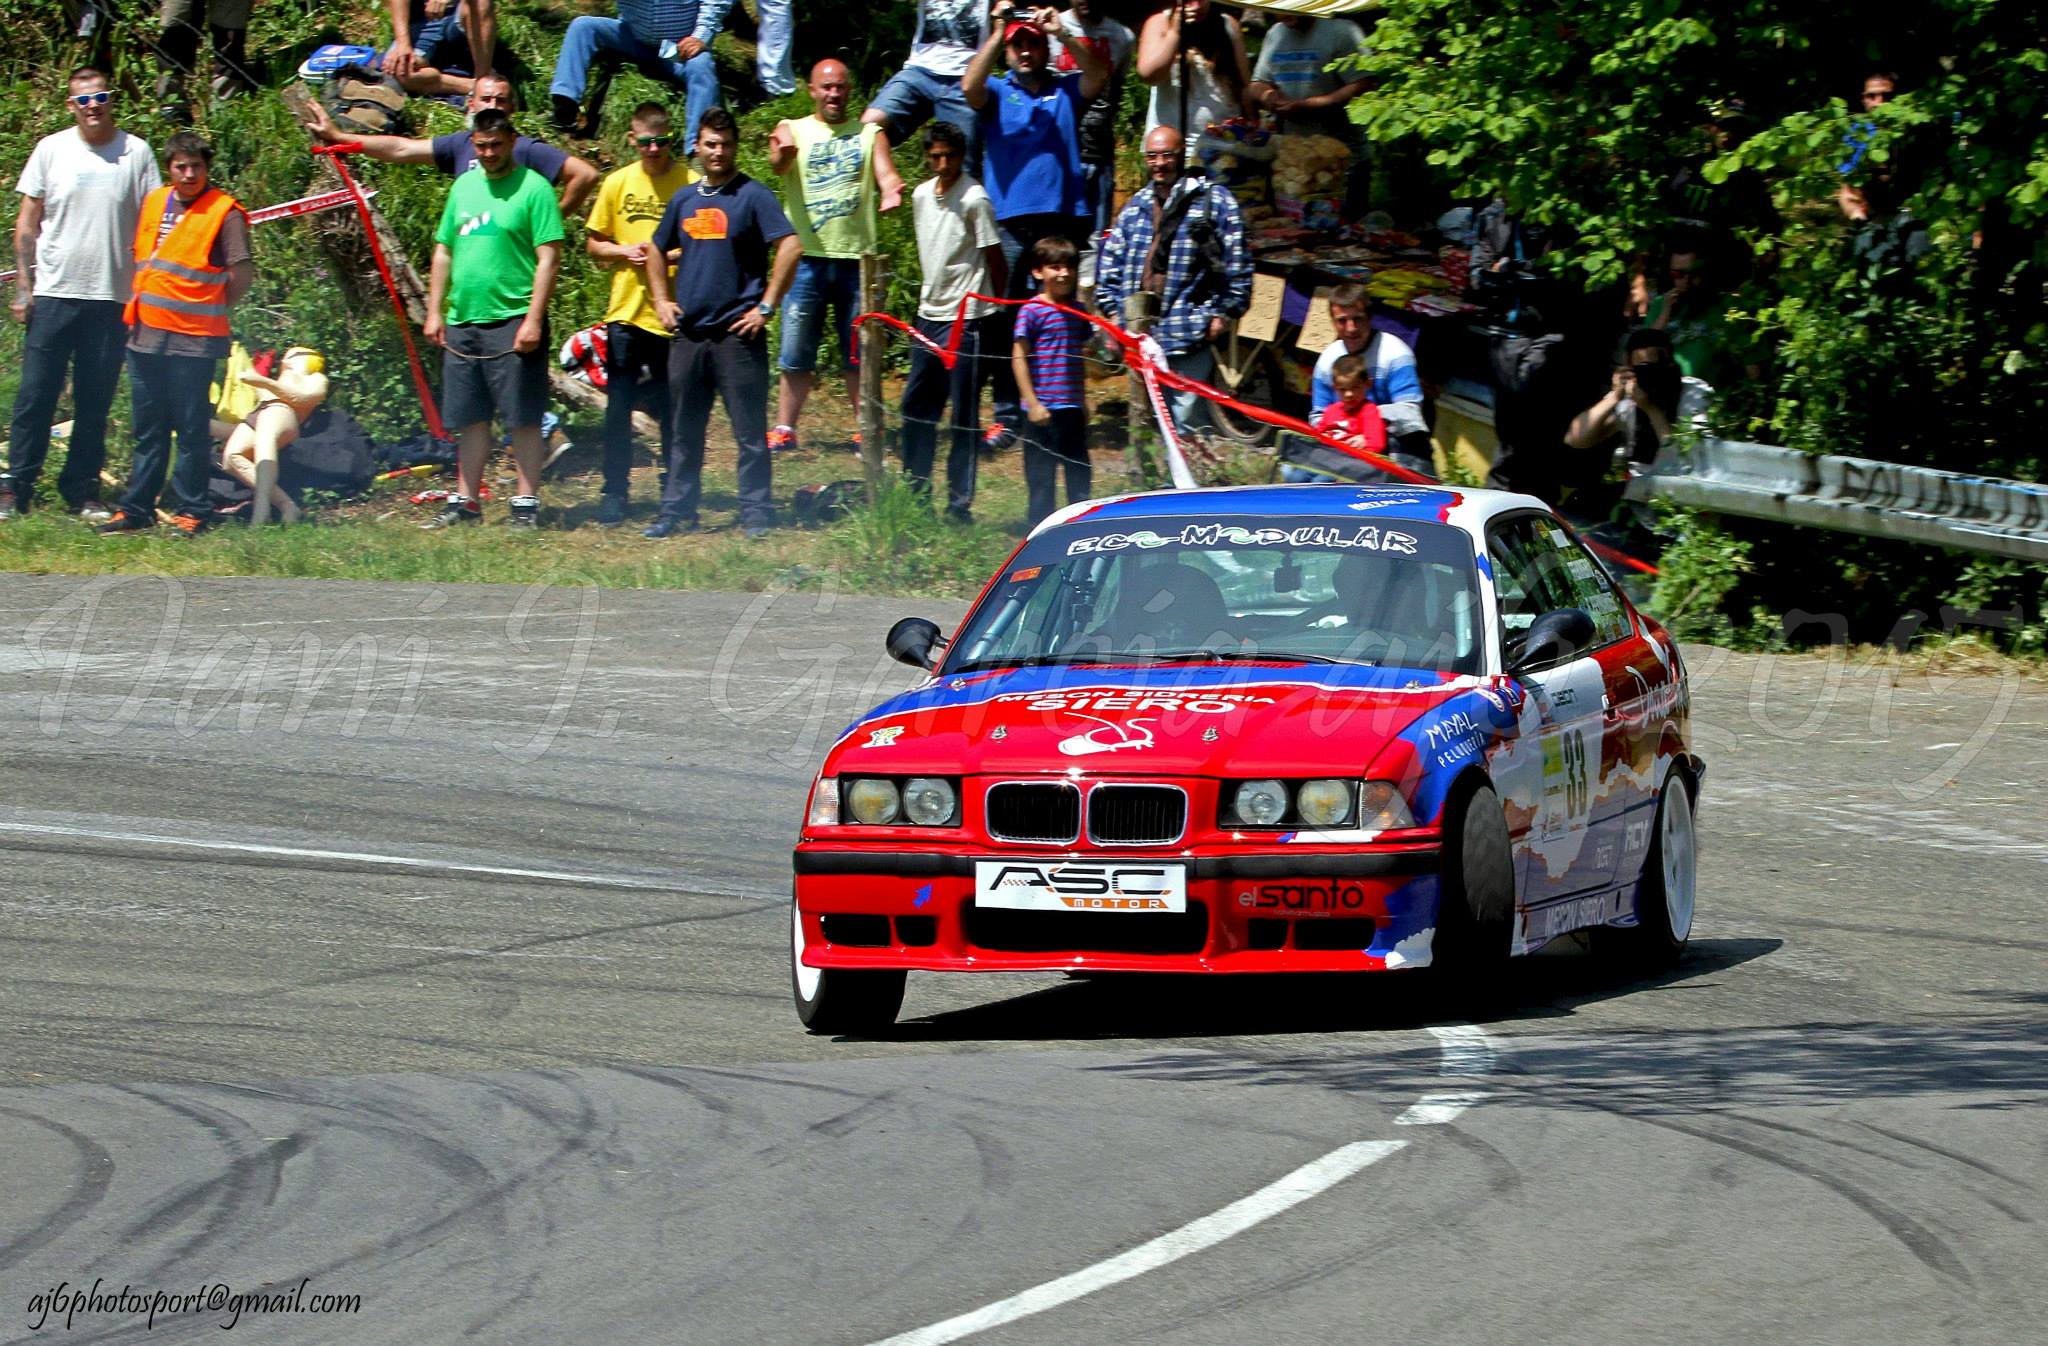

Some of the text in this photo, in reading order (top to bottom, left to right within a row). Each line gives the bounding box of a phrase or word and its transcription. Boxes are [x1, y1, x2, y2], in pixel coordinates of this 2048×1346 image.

[997, 690, 1277, 704] MESON SIDRERIA
[1026, 697, 1236, 713] SIERO
[1425, 711, 1479, 750] MAYAL
[1563, 728, 1588, 820] 33
[989, 866, 1172, 895] ASC
[1073, 898, 1160, 909] MOTOR
